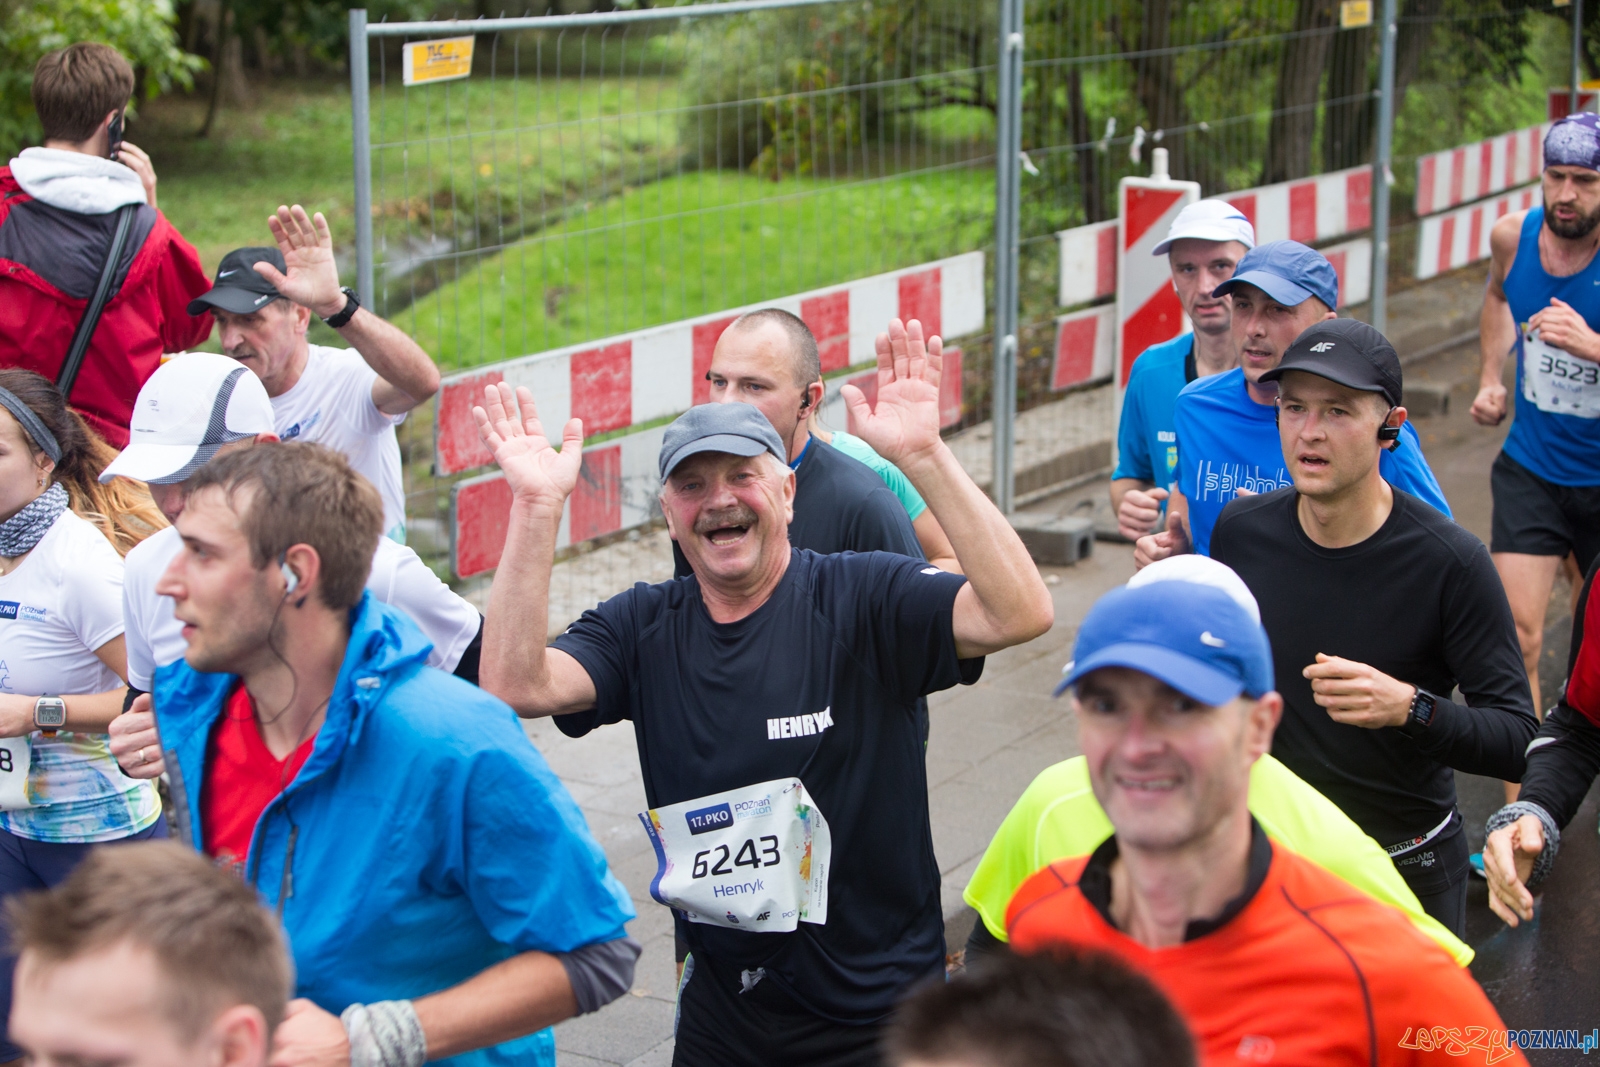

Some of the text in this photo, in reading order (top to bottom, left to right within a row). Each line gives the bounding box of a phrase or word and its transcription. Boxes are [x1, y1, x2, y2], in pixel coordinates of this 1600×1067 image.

[1309, 341, 1336, 353] 4F
[1539, 354, 1599, 385] 3523
[766, 705, 835, 740] HENRYK
[690, 810, 729, 828] 17.PKO
[736, 805, 772, 820] maraton
[1386, 834, 1427, 855] RIATHLON
[692, 834, 781, 879] 6243
[713, 878, 765, 898] Henryk
